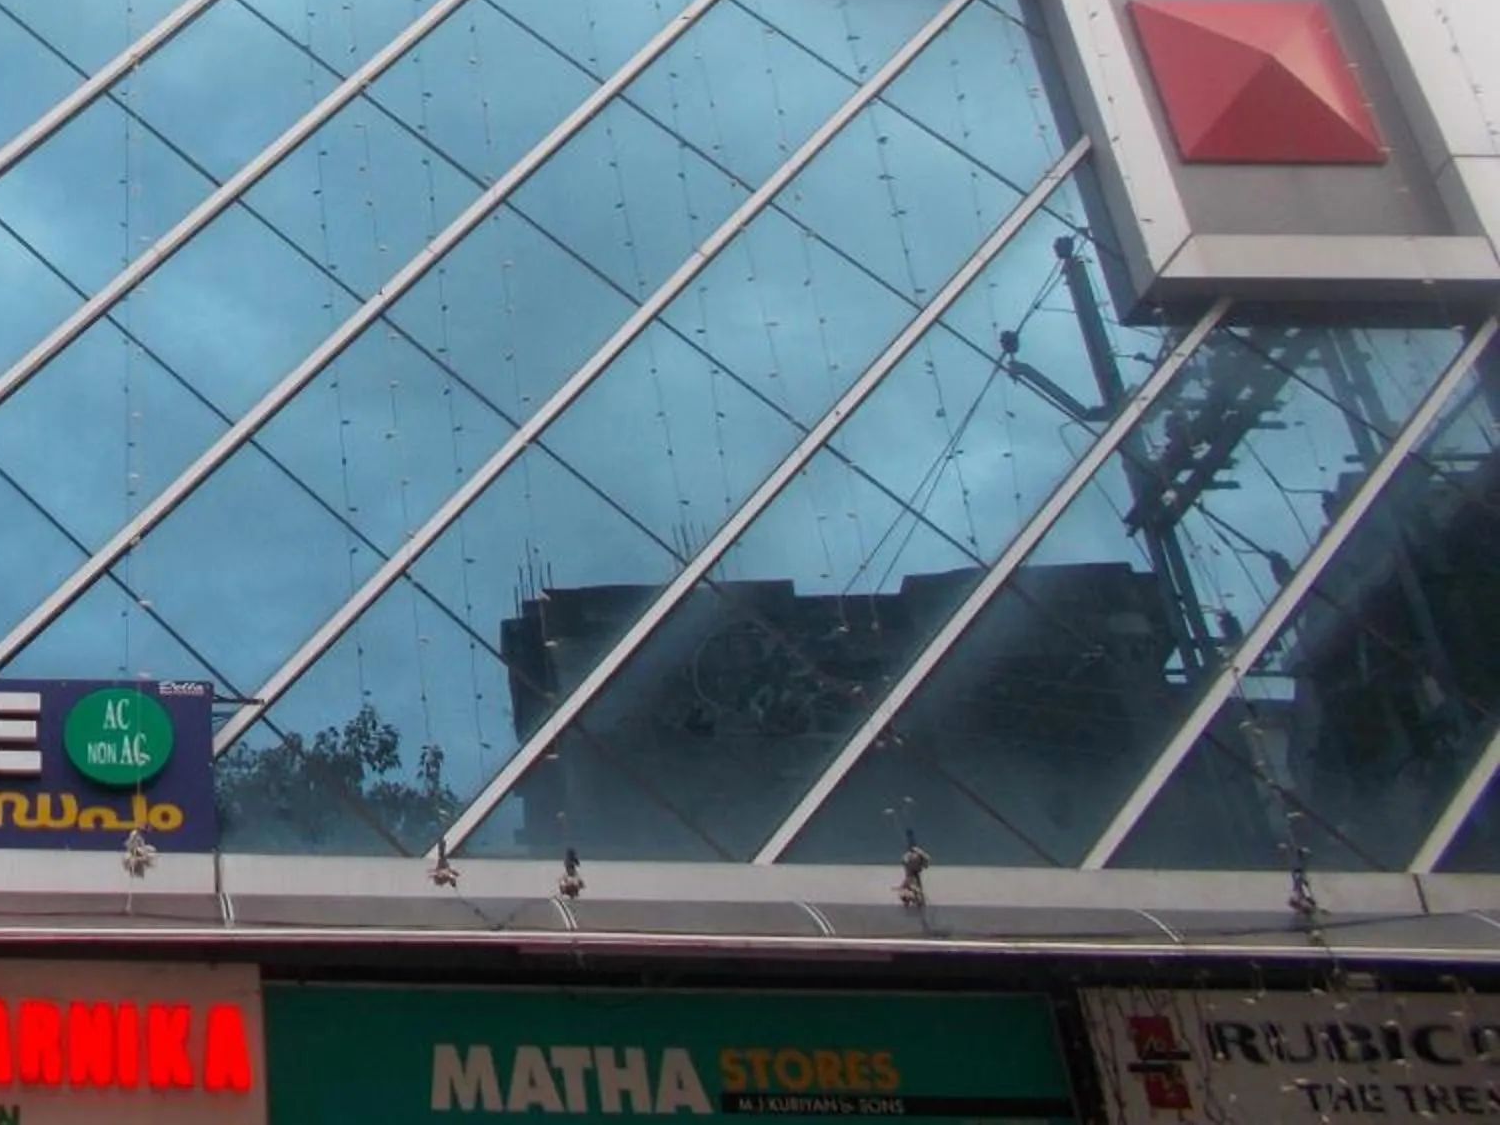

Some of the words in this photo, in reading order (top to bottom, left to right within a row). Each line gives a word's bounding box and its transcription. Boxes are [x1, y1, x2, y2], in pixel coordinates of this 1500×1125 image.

[103, 699, 130, 730] AC
[87, 741, 117, 764] NON
[431, 1043, 714, 1115] MATHA
[720, 1048, 901, 1092] STORES
[1298, 1083, 1385, 1114] THE
